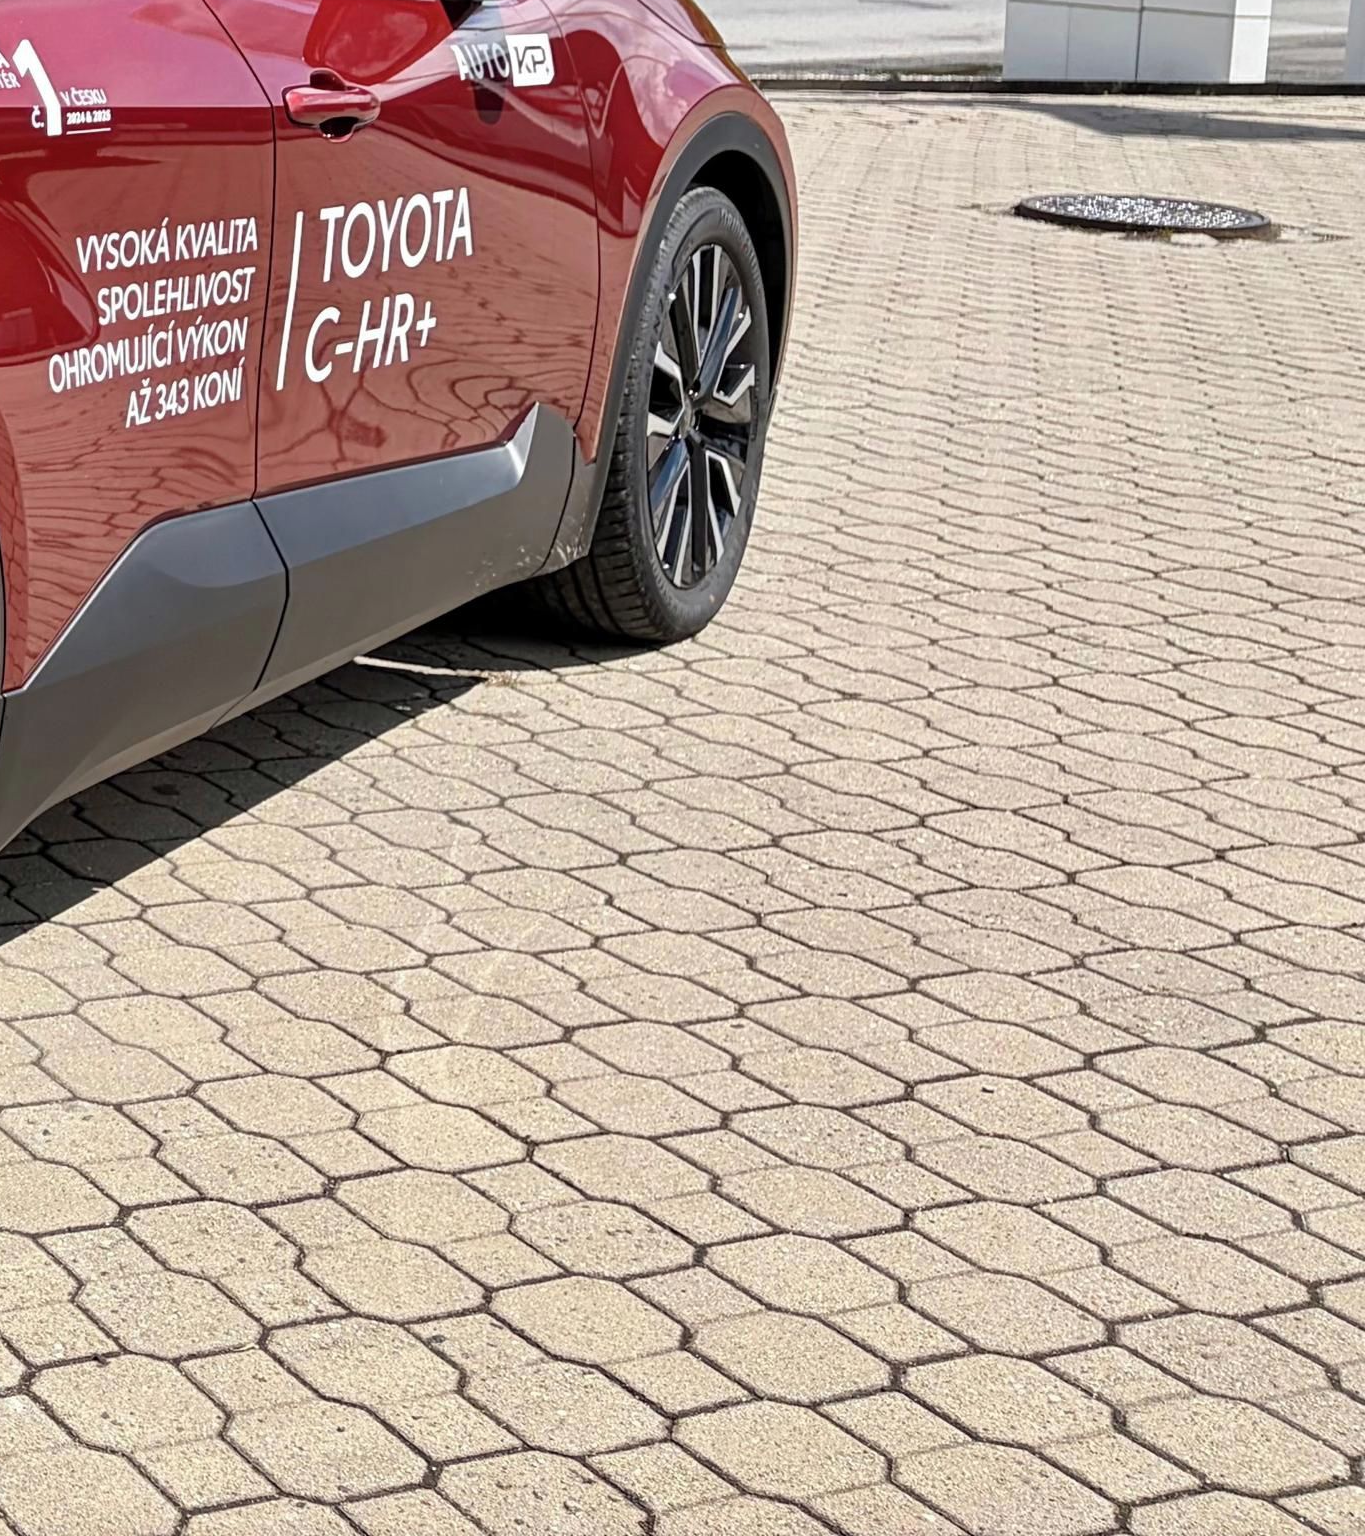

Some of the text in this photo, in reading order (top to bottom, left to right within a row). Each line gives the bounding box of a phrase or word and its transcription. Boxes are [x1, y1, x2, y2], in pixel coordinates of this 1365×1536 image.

[12, 39, 62, 136] 1
[70, 87, 107, 106] ČESKU
[450, 43, 510, 81] AUTO
[76, 217, 258, 273] VYSOKÁ KVALITA
[320, 187, 473, 283] TOYOTA
[97, 267, 256, 326] SPOLEHLIVOST
[49, 315, 249, 393] OHROMUJÍCÍ VÝKON
[305, 293, 437, 383] C-HR+
[125, 357, 245, 428] AŽ 343 KONÍ
